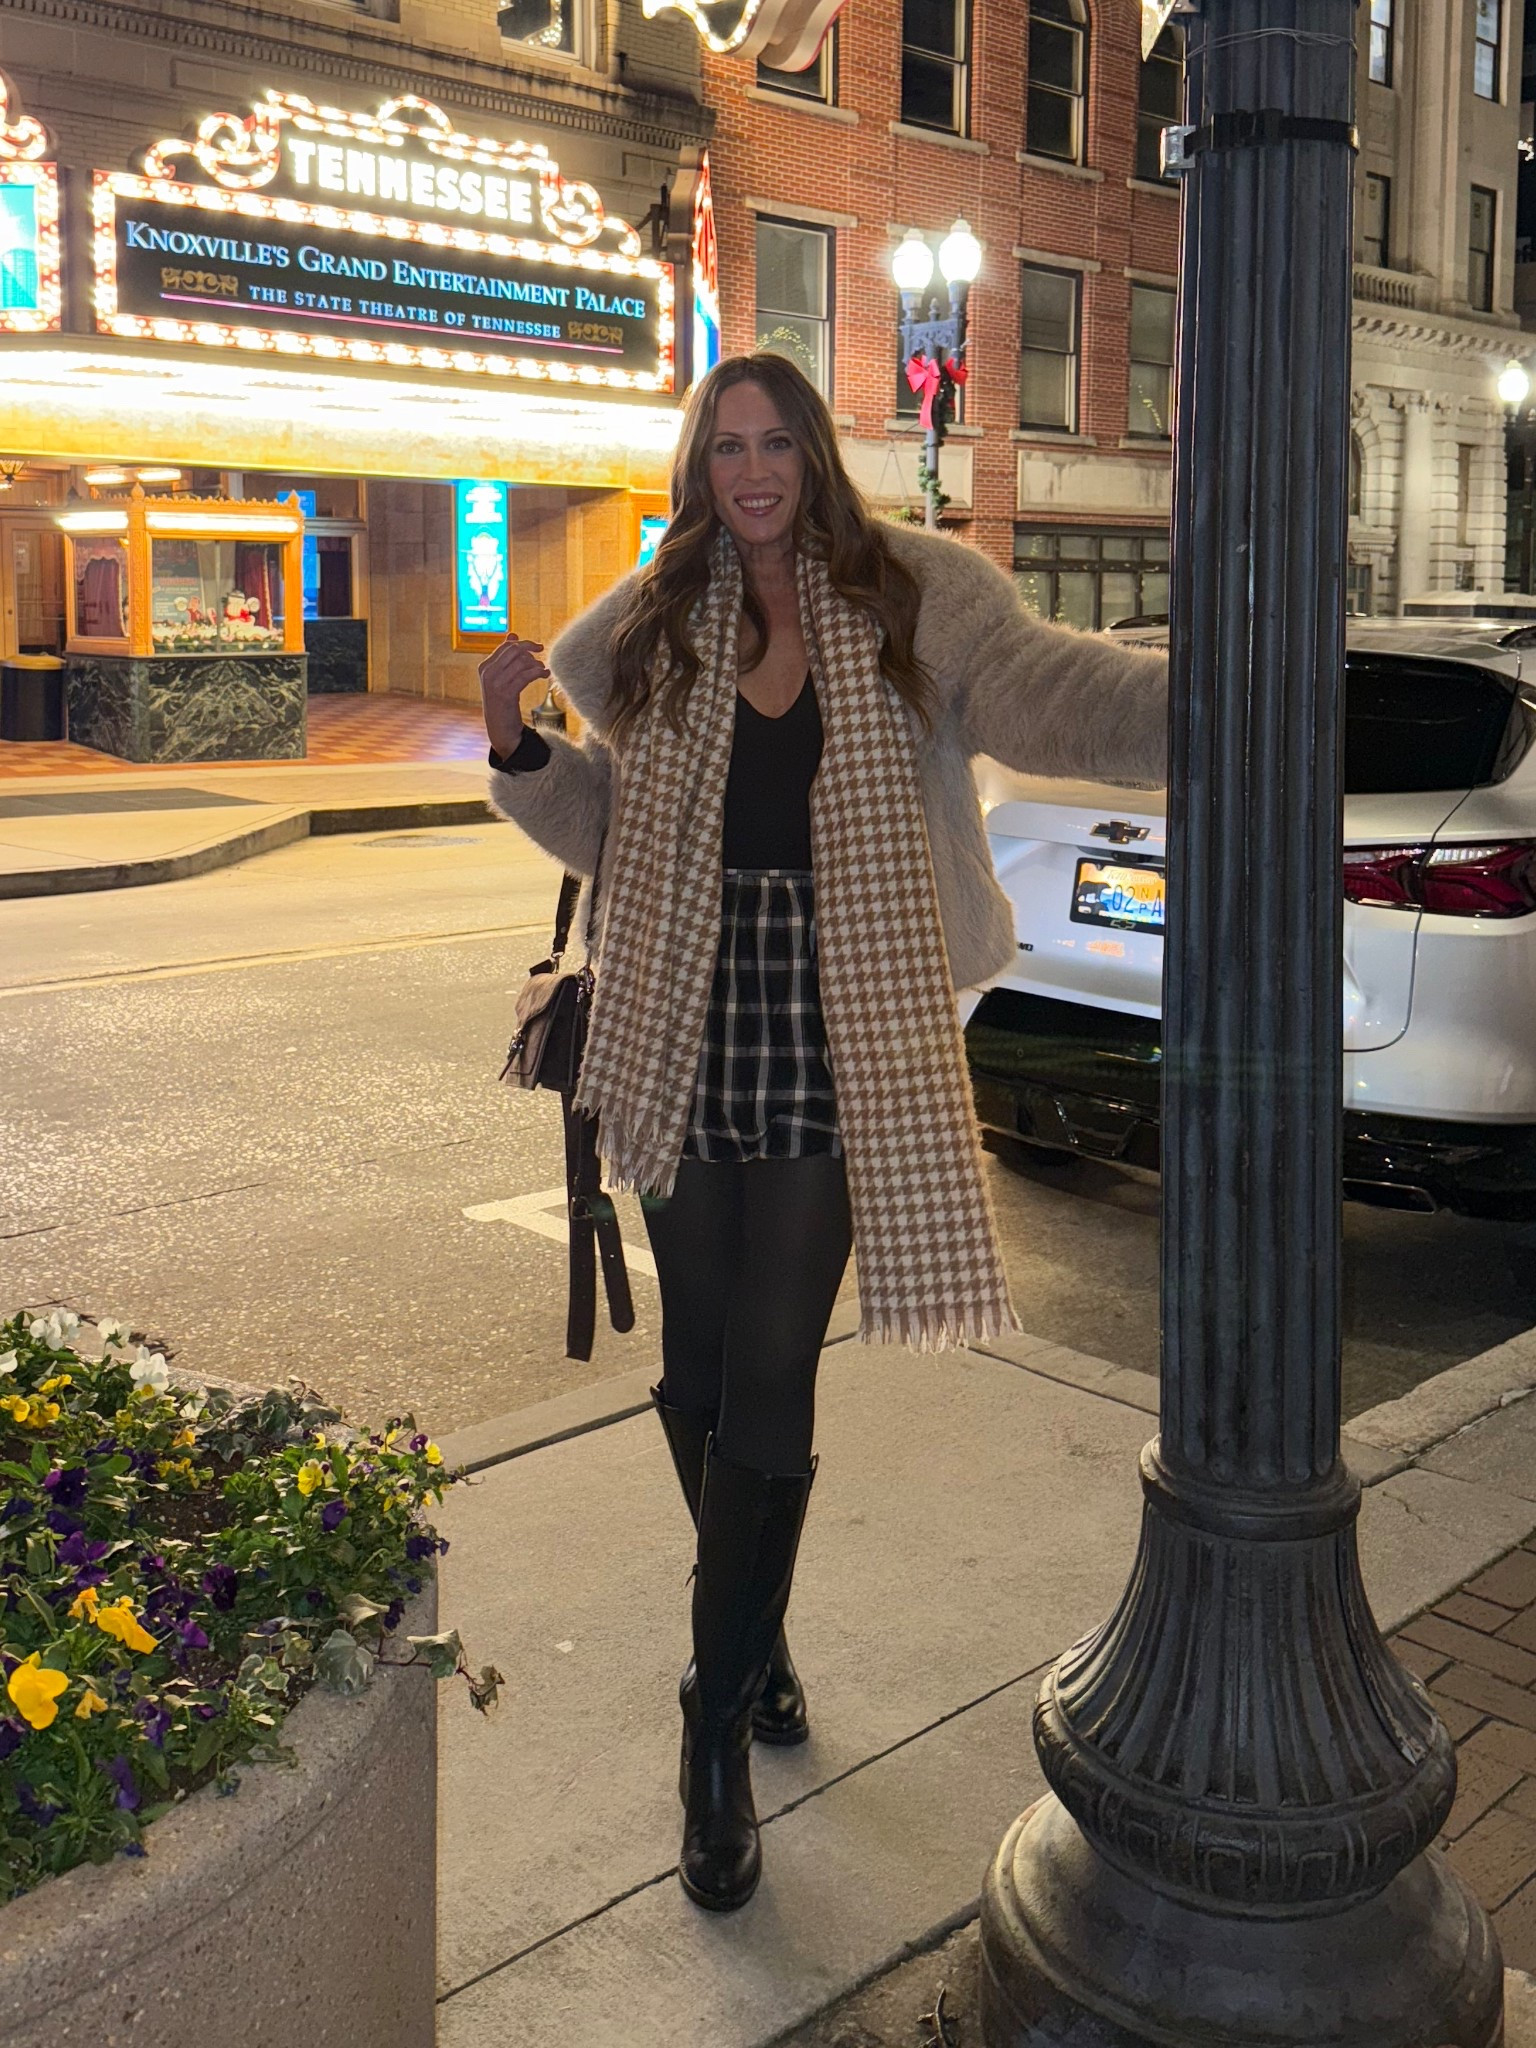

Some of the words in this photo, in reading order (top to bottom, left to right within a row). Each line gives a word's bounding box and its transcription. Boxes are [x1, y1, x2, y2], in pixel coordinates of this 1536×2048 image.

[287, 138, 532, 223] TENNESSEE
[125, 220, 290, 267] KNOXVILLE'S
[298, 245, 388, 282] GRAND
[393, 260, 570, 308] ENTERTAINMENT
[575, 287, 646, 319] PALACE
[249, 285, 287, 304] THE
[294, 290, 352, 313] STATE
[359, 299, 438, 323] THEATRE
[444, 311, 466, 326] OF
[472, 315, 561, 339] TENNESSEE
